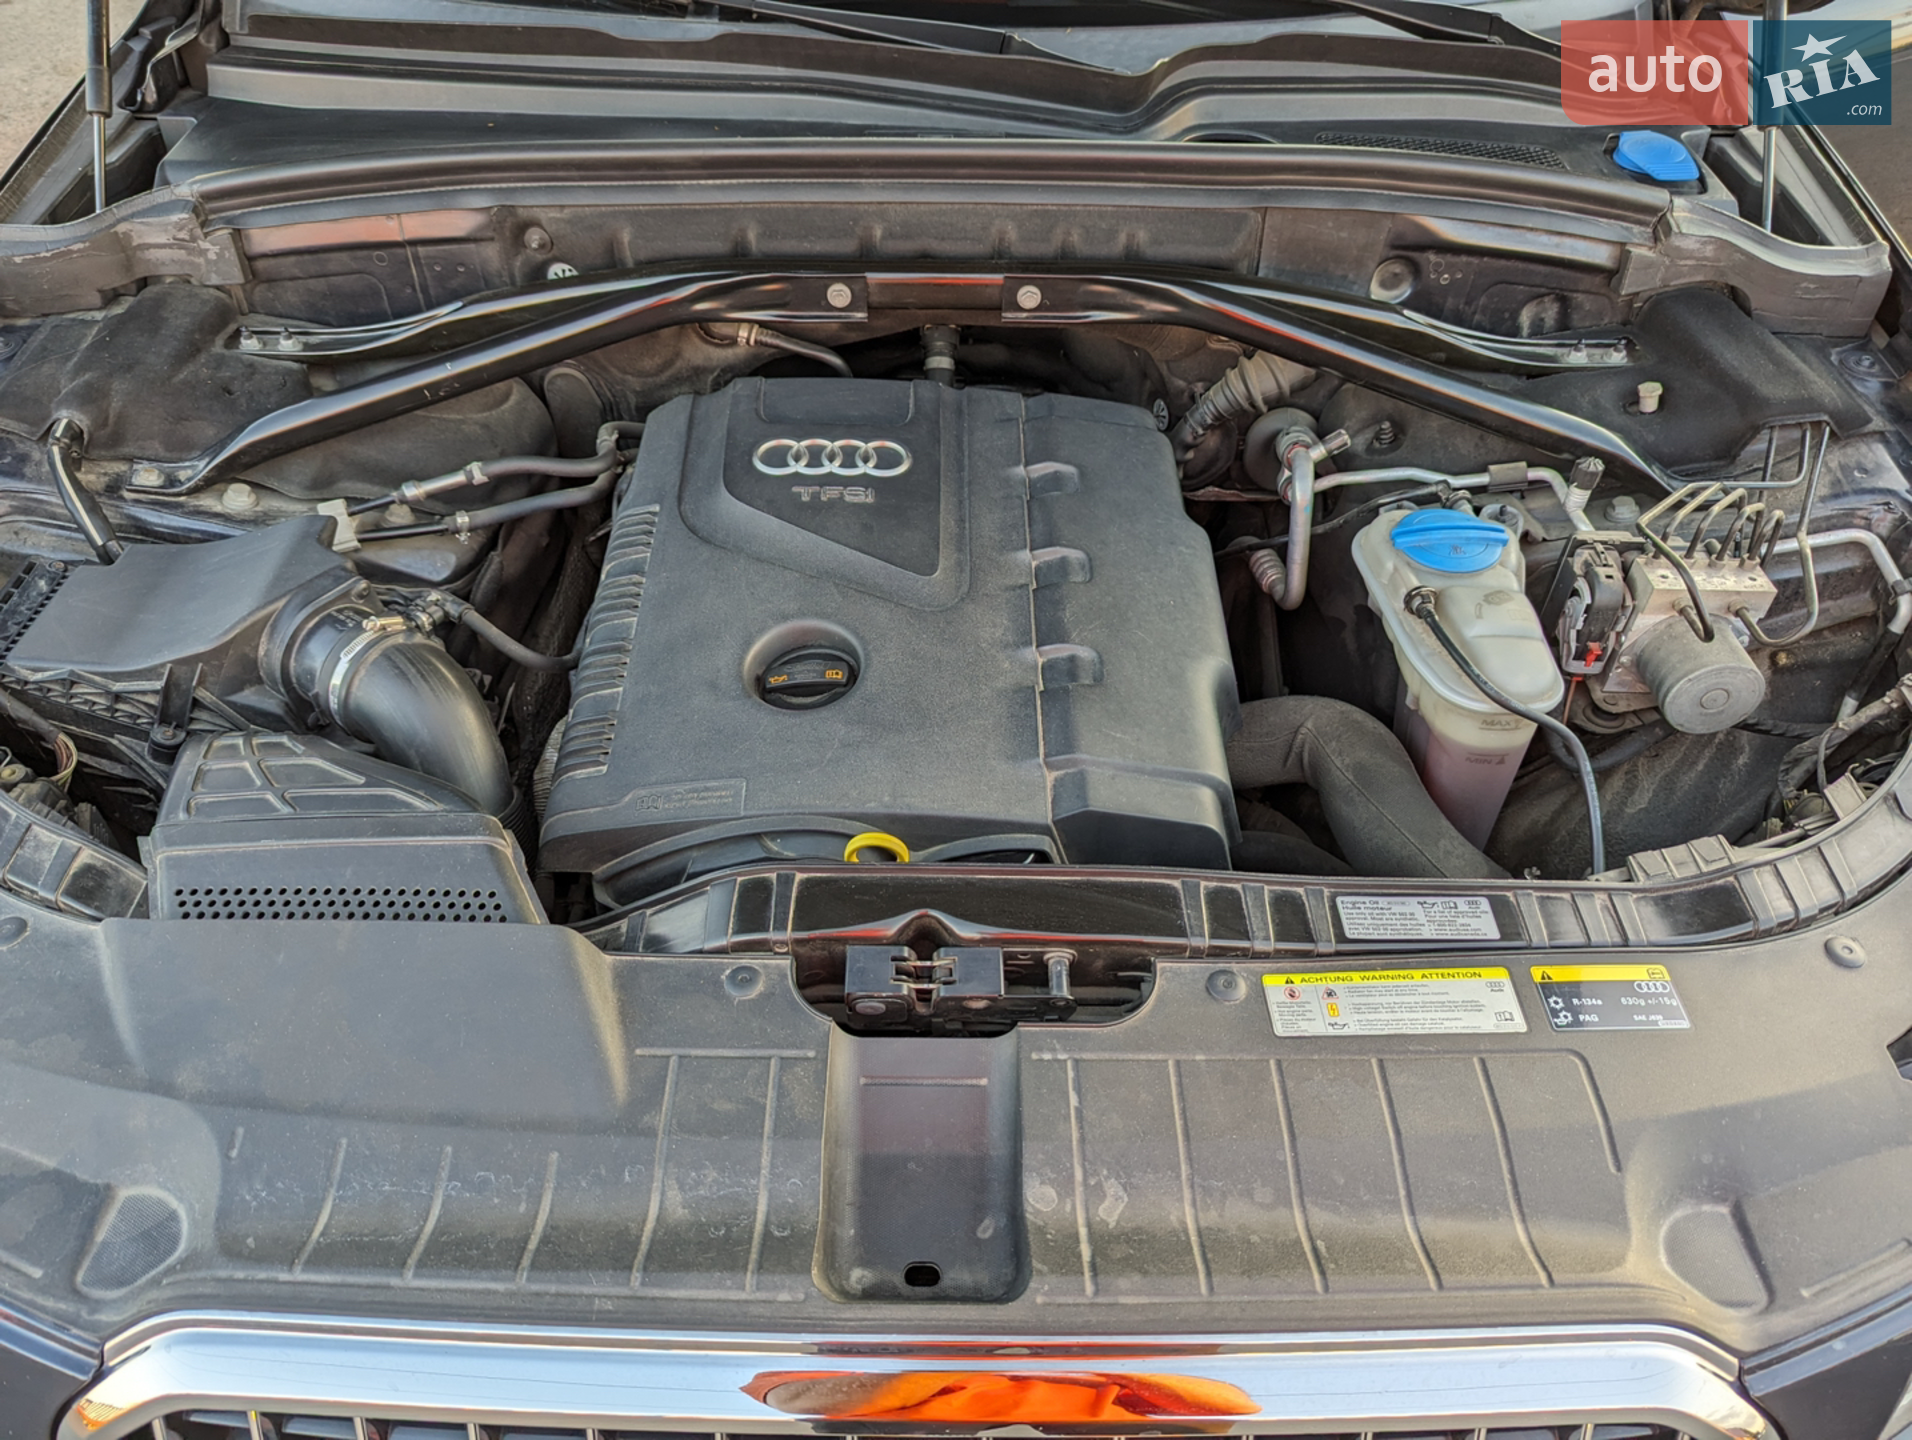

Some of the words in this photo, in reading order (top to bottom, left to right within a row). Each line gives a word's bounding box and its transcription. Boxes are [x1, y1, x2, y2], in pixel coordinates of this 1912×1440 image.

[791, 485, 875, 503] TFSI
[1481, 719, 1512, 727] MAX
[1465, 756, 1493, 765] MIN
[1359, 973, 1415, 982] WARNING
[1420, 971, 1482, 980] ATTENTION
[1578, 1014, 1599, 1022] PAG
